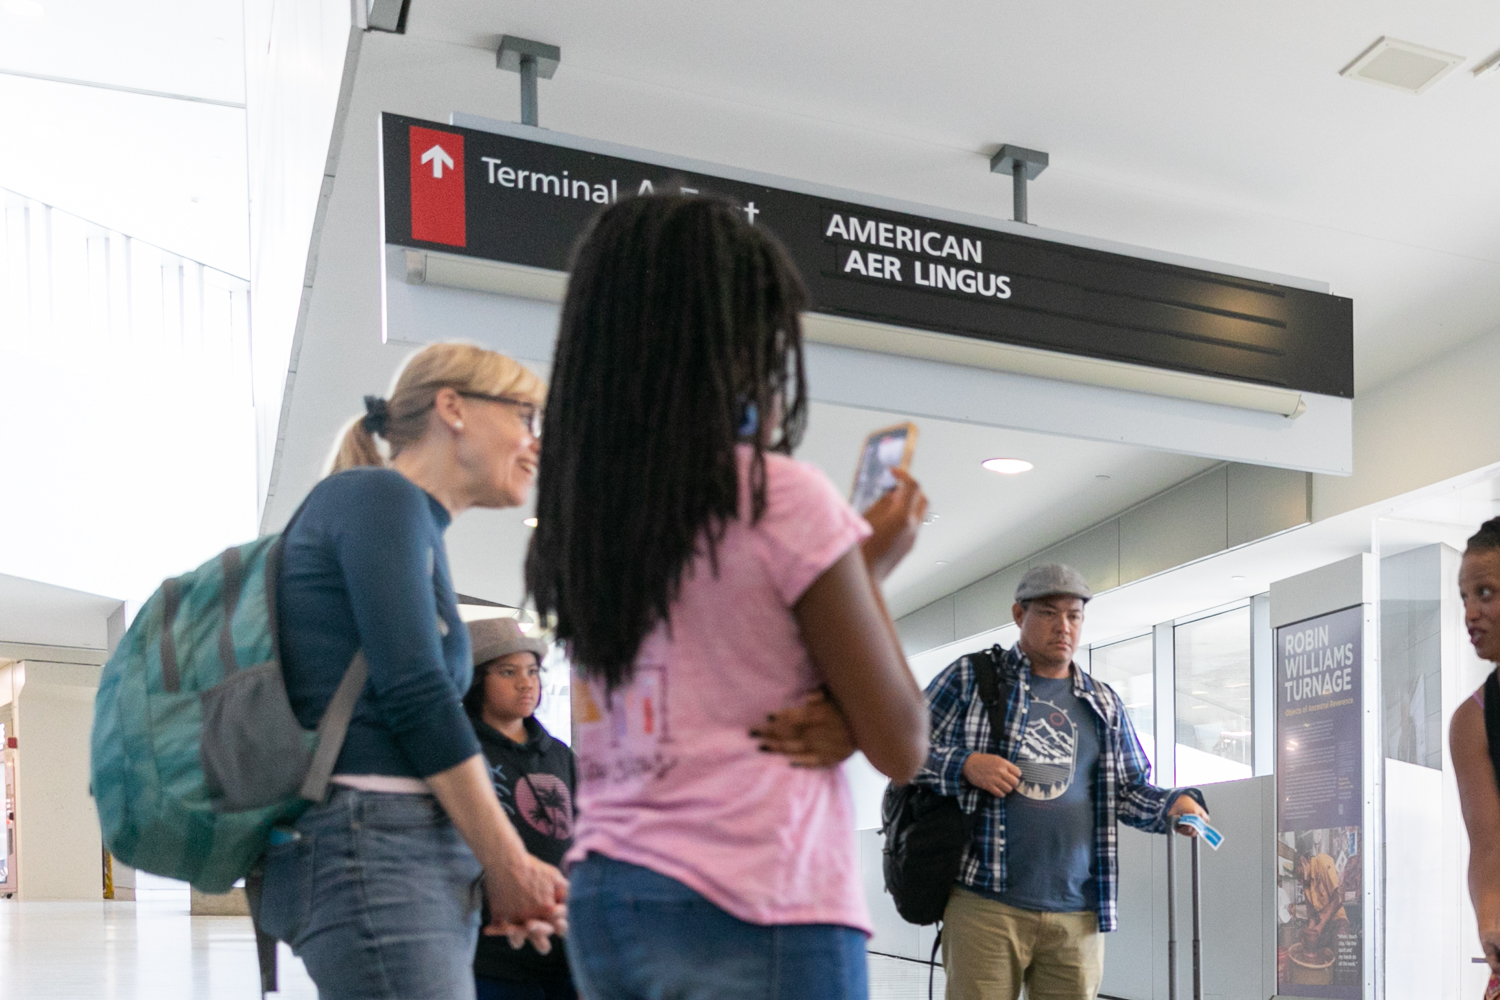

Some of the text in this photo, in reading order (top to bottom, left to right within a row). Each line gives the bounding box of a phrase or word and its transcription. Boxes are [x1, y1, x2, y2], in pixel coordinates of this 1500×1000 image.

[481, 156, 618, 205] Terminal
[826, 213, 983, 264] AMERICAN
[843, 250, 1012, 300] AER LINGUS
[1284, 642, 1354, 679] WILLIAMS
[1285, 624, 1329, 657] ROBIN
[1284, 667, 1352, 702] TURNAGE
